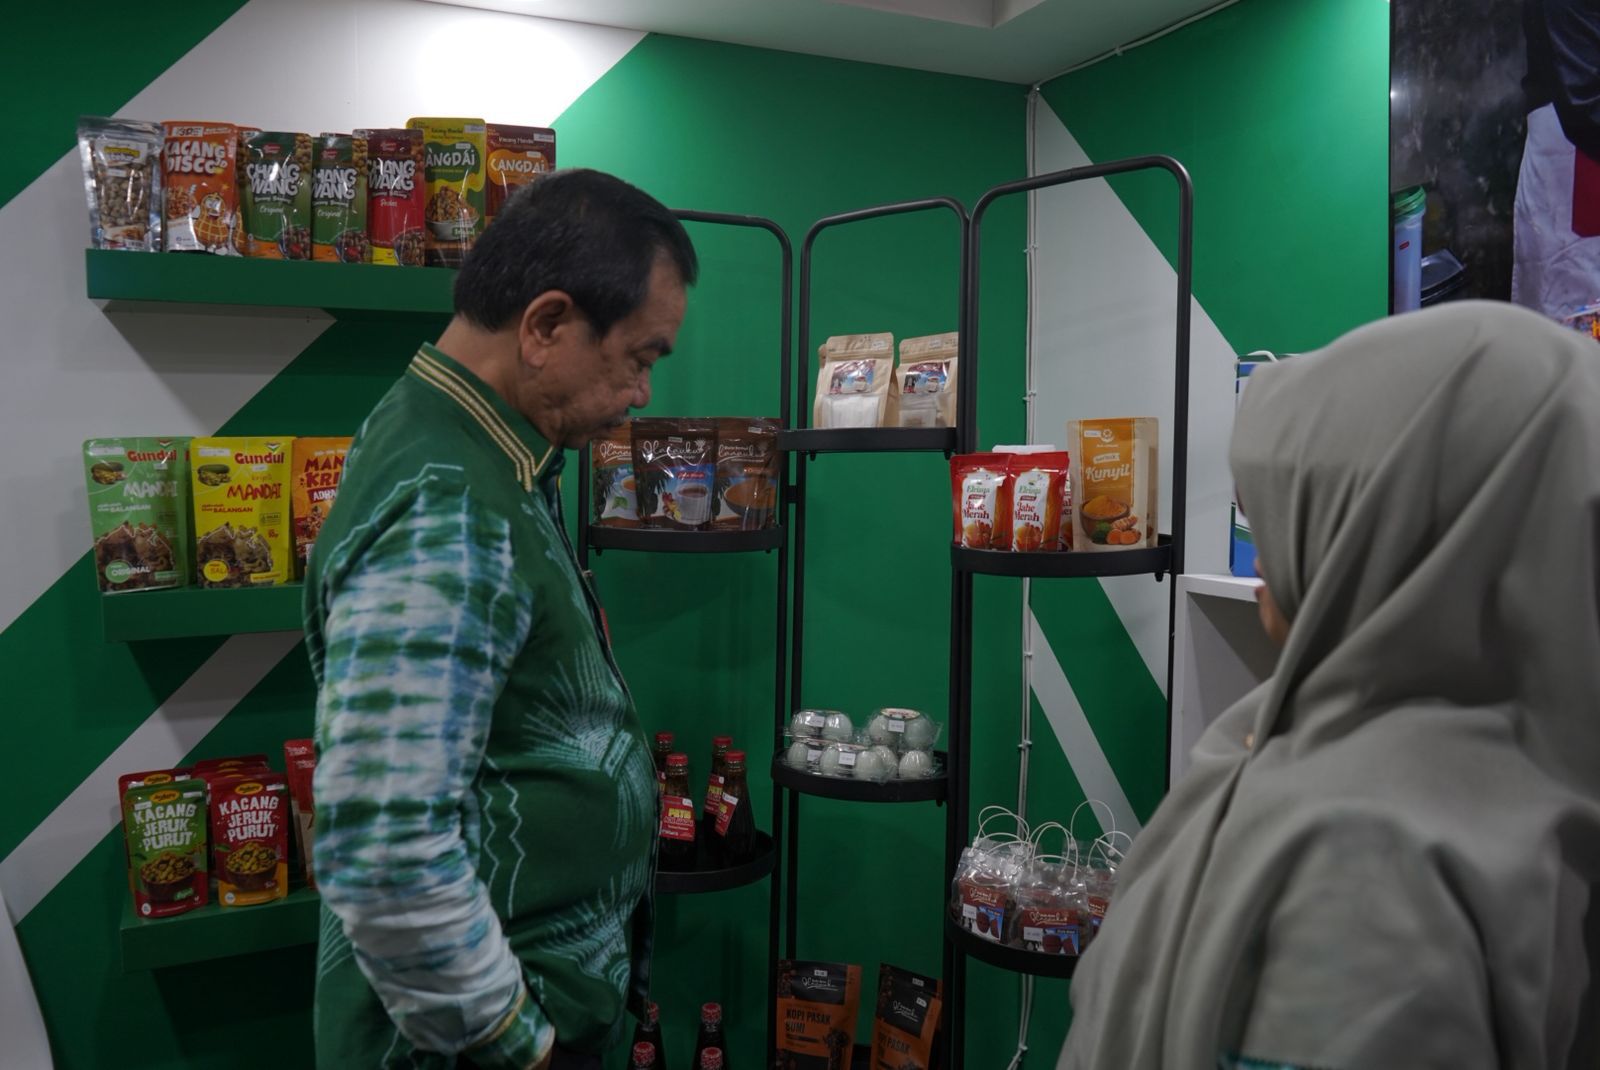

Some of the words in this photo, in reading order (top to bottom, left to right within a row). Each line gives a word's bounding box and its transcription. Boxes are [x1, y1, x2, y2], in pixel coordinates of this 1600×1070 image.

[166, 155, 216, 175] DISCO
[246, 163, 301, 182] CHANG
[312, 168, 358, 186] HANG
[367, 174, 415, 191] WANG
[250, 177, 298, 197] WANG
[127, 449, 177, 463] Gundul
[234, 452, 285, 465] Gundul
[304, 456, 345, 472] MAN
[306, 472, 340, 488] KRI
[123, 481, 178, 498] MANDAI
[227, 482, 283, 501] MANDAI
[1015, 511, 1040, 521] Merah
[1017, 502, 1036, 512] Jahe
[133, 803, 197, 825] KACANG
[218, 795, 280, 816] KACANG
[143, 818, 190, 837] JERUK
[228, 811, 272, 828] JERUK
[142, 831, 193, 852] PURUT
[227, 824, 276, 842] PURUT
[786, 1007, 805, 1020] KOPI
[806, 1011, 831, 1025] PASAK
[785, 1021, 806, 1033] BUMI
